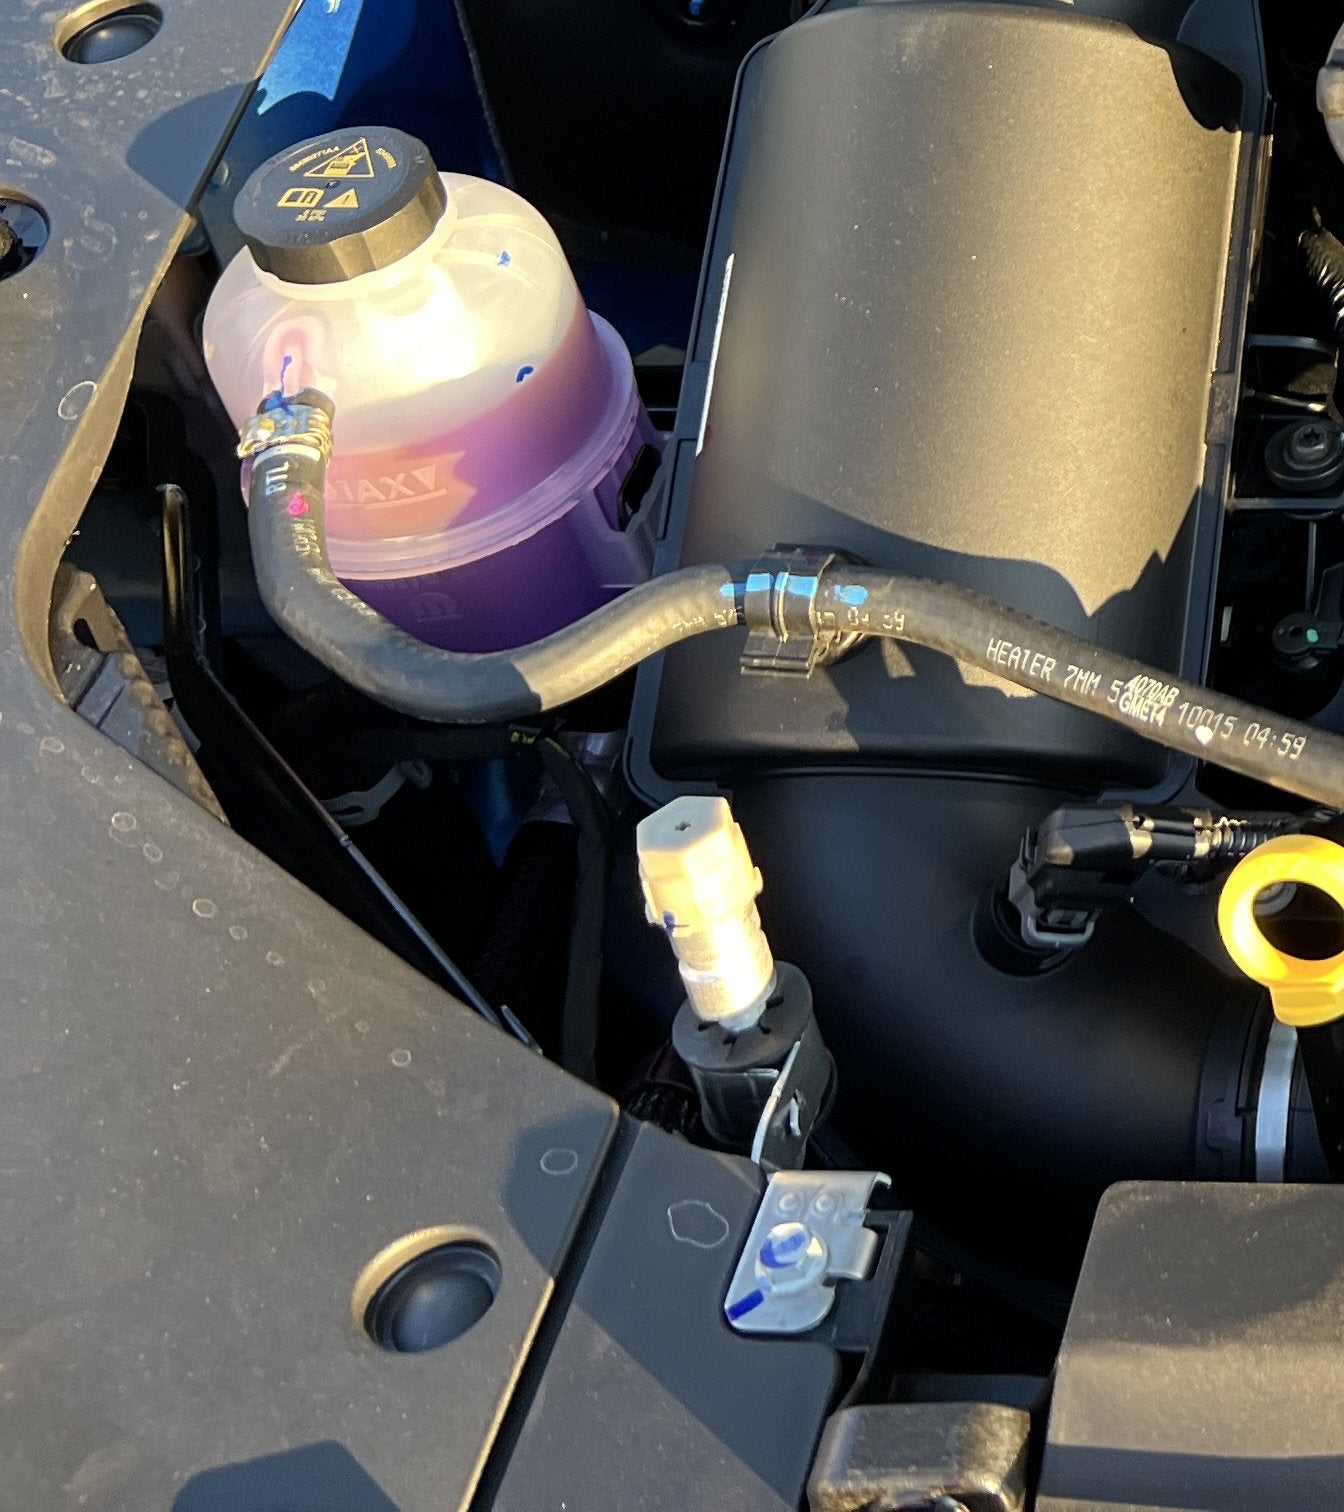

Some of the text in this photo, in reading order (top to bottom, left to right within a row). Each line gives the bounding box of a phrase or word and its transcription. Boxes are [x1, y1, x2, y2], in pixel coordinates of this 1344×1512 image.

[986, 638, 1057, 682] HEATER
[1064, 664, 1102, 697] 7MM
[1243, 722, 1308, 761] 04:59
